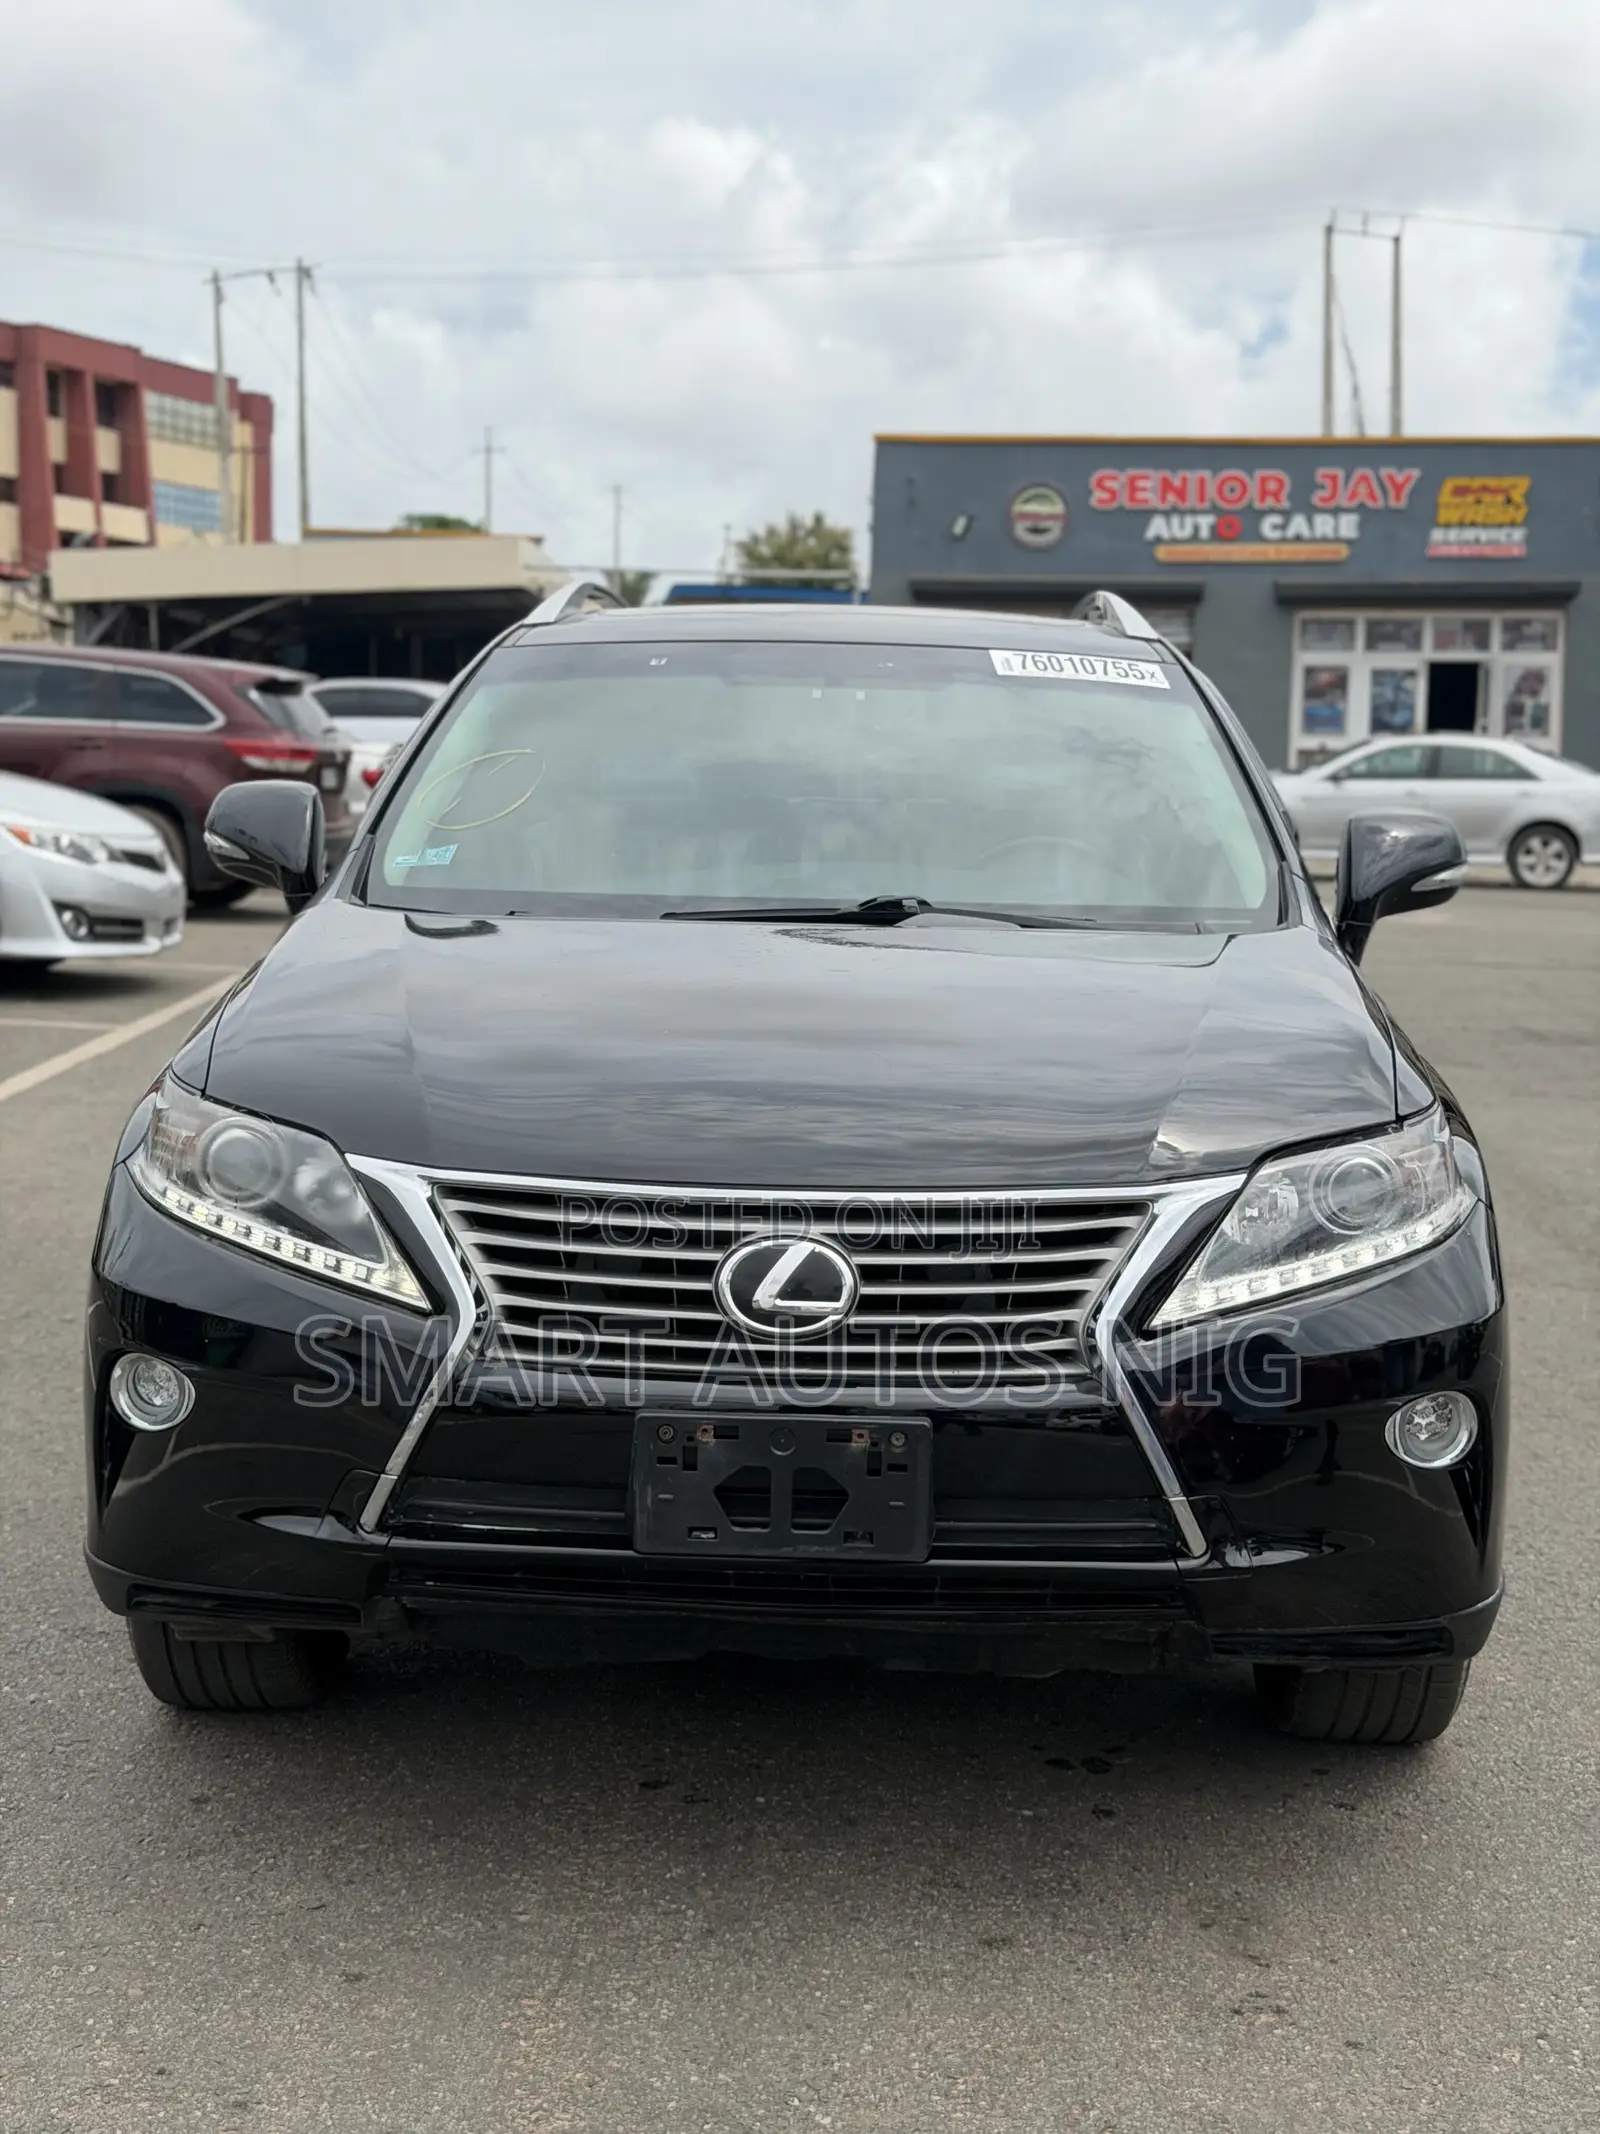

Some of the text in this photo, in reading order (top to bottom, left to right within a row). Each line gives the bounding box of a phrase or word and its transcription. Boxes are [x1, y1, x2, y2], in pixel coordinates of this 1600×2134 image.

[1090, 469, 1290, 509] SENIOR
[1312, 468, 1420, 509] JAY
[1145, 513, 1360, 540] AUTO CARE
